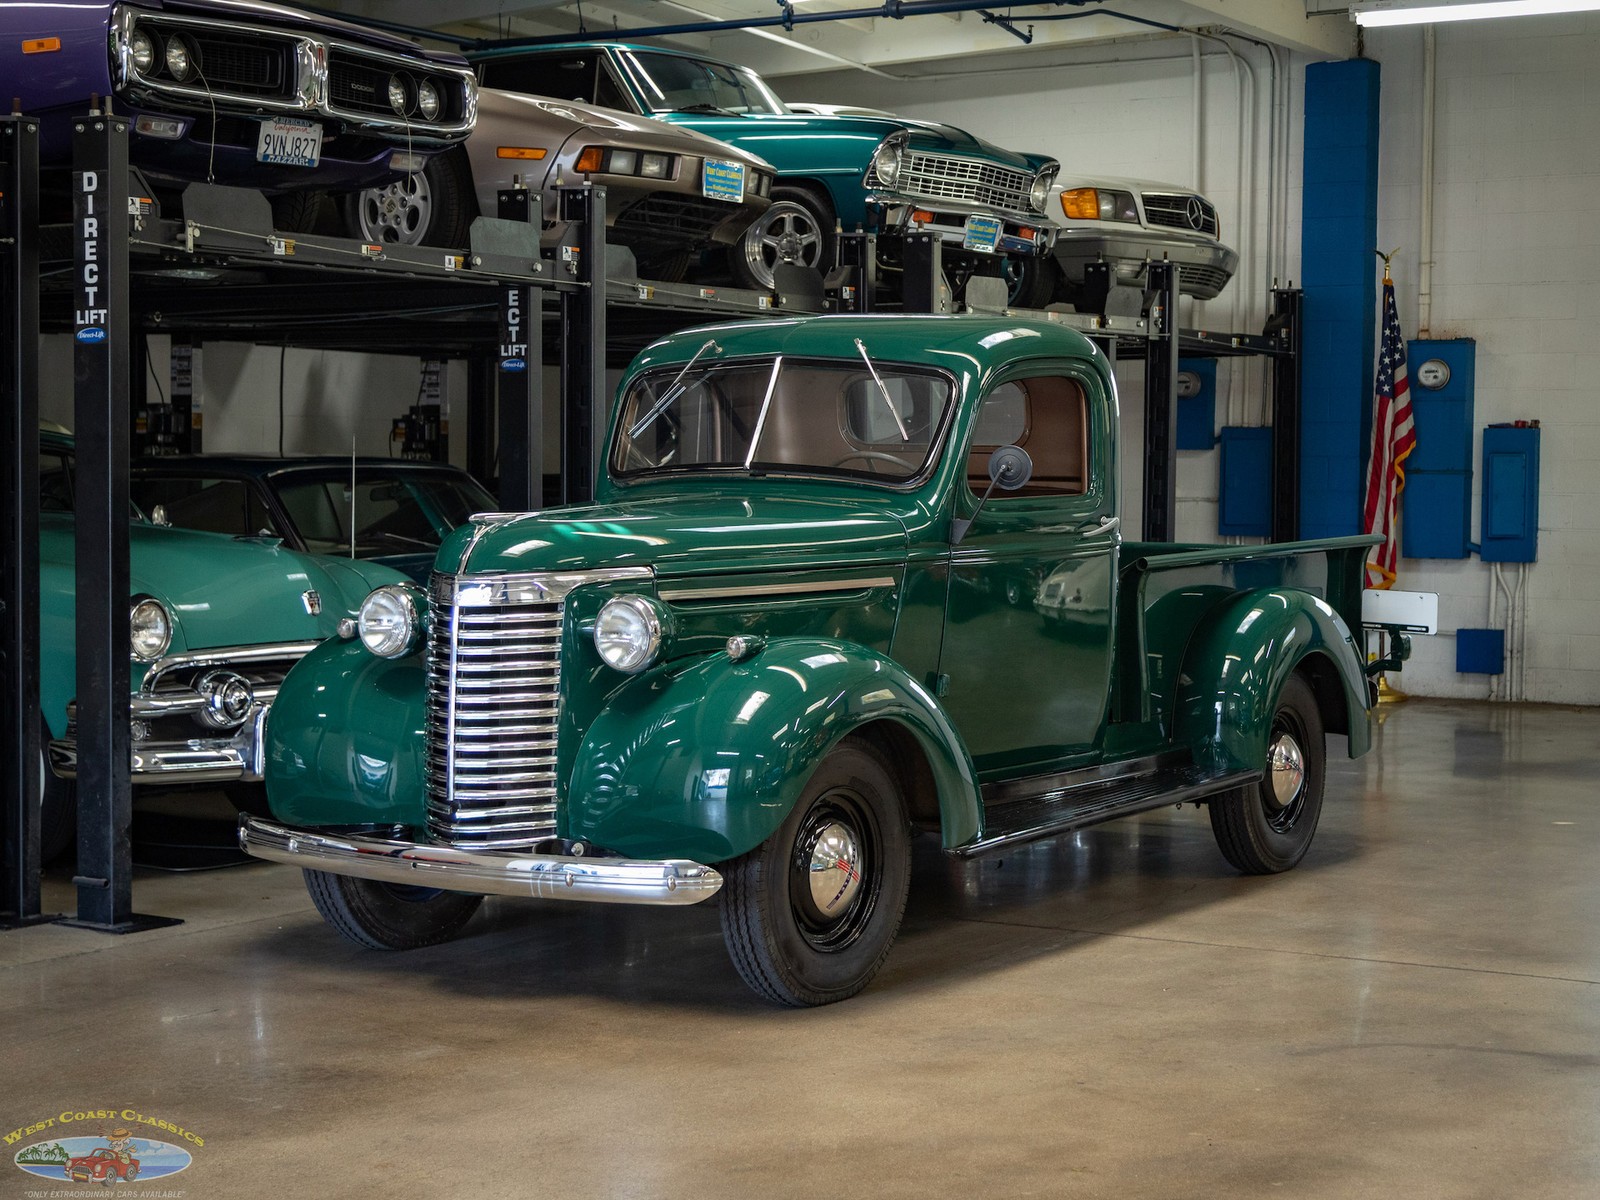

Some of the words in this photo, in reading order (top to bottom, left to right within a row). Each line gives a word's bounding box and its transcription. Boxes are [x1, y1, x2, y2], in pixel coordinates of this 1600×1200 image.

[263, 133, 317, 158] 9VNJ827
[82, 171, 99, 307] DIRECT
[76, 309, 108, 325] LIFT
[507, 289, 520, 342] ECT
[500, 344, 527, 357] LIFT
